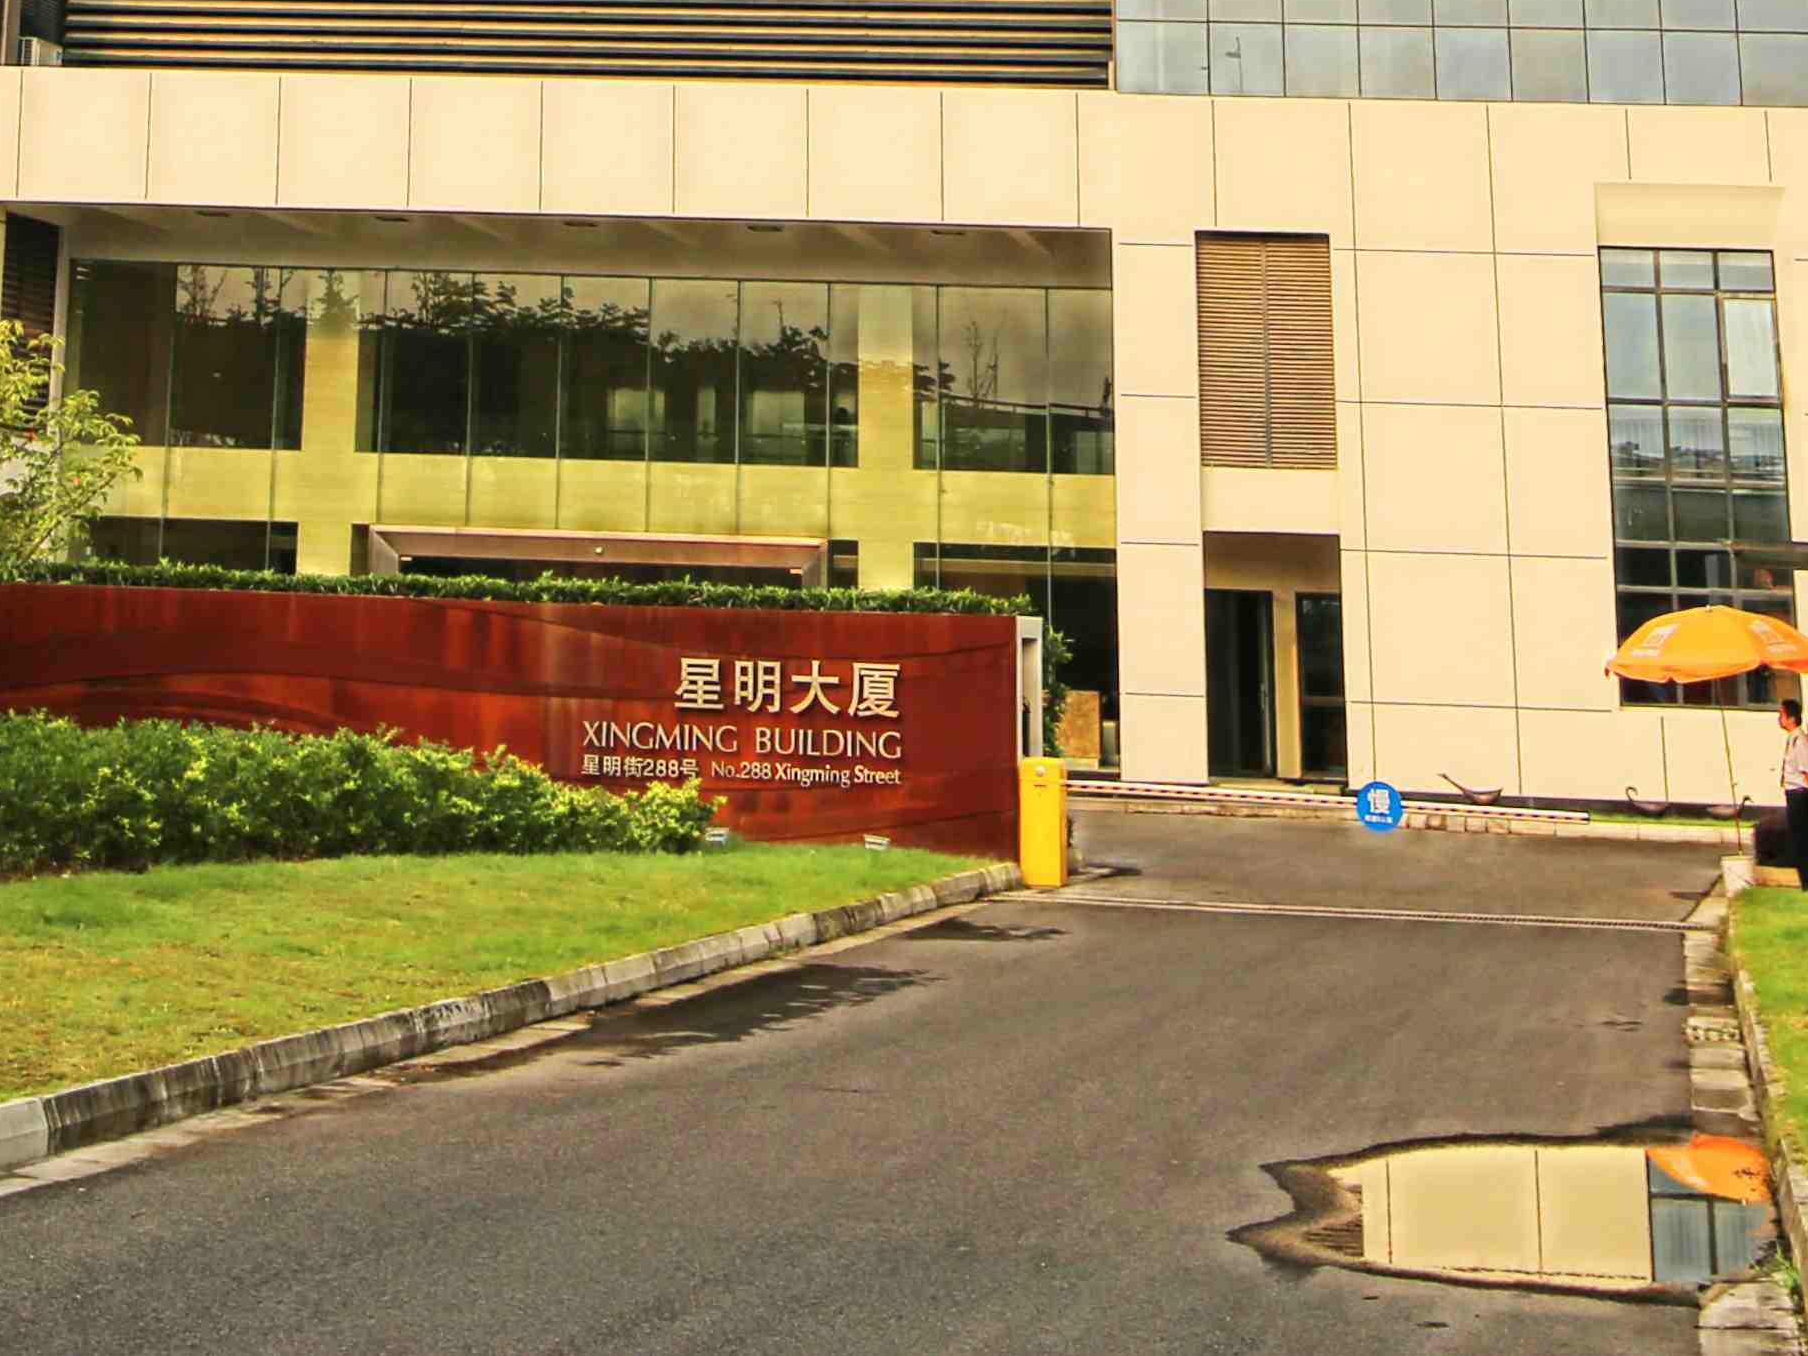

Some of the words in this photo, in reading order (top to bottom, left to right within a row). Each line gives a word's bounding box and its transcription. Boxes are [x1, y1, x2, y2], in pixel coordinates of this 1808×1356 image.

[673, 656, 901, 719] 星明大厦
[582, 720, 738, 754] XINGMING
[755, 726, 902, 760] BUILDING
[581, 753, 700, 779] 星明街288号
[711, 760, 772, 780] No.288
[774, 763, 850, 788] Xingming
[854, 764, 901, 786] Street
